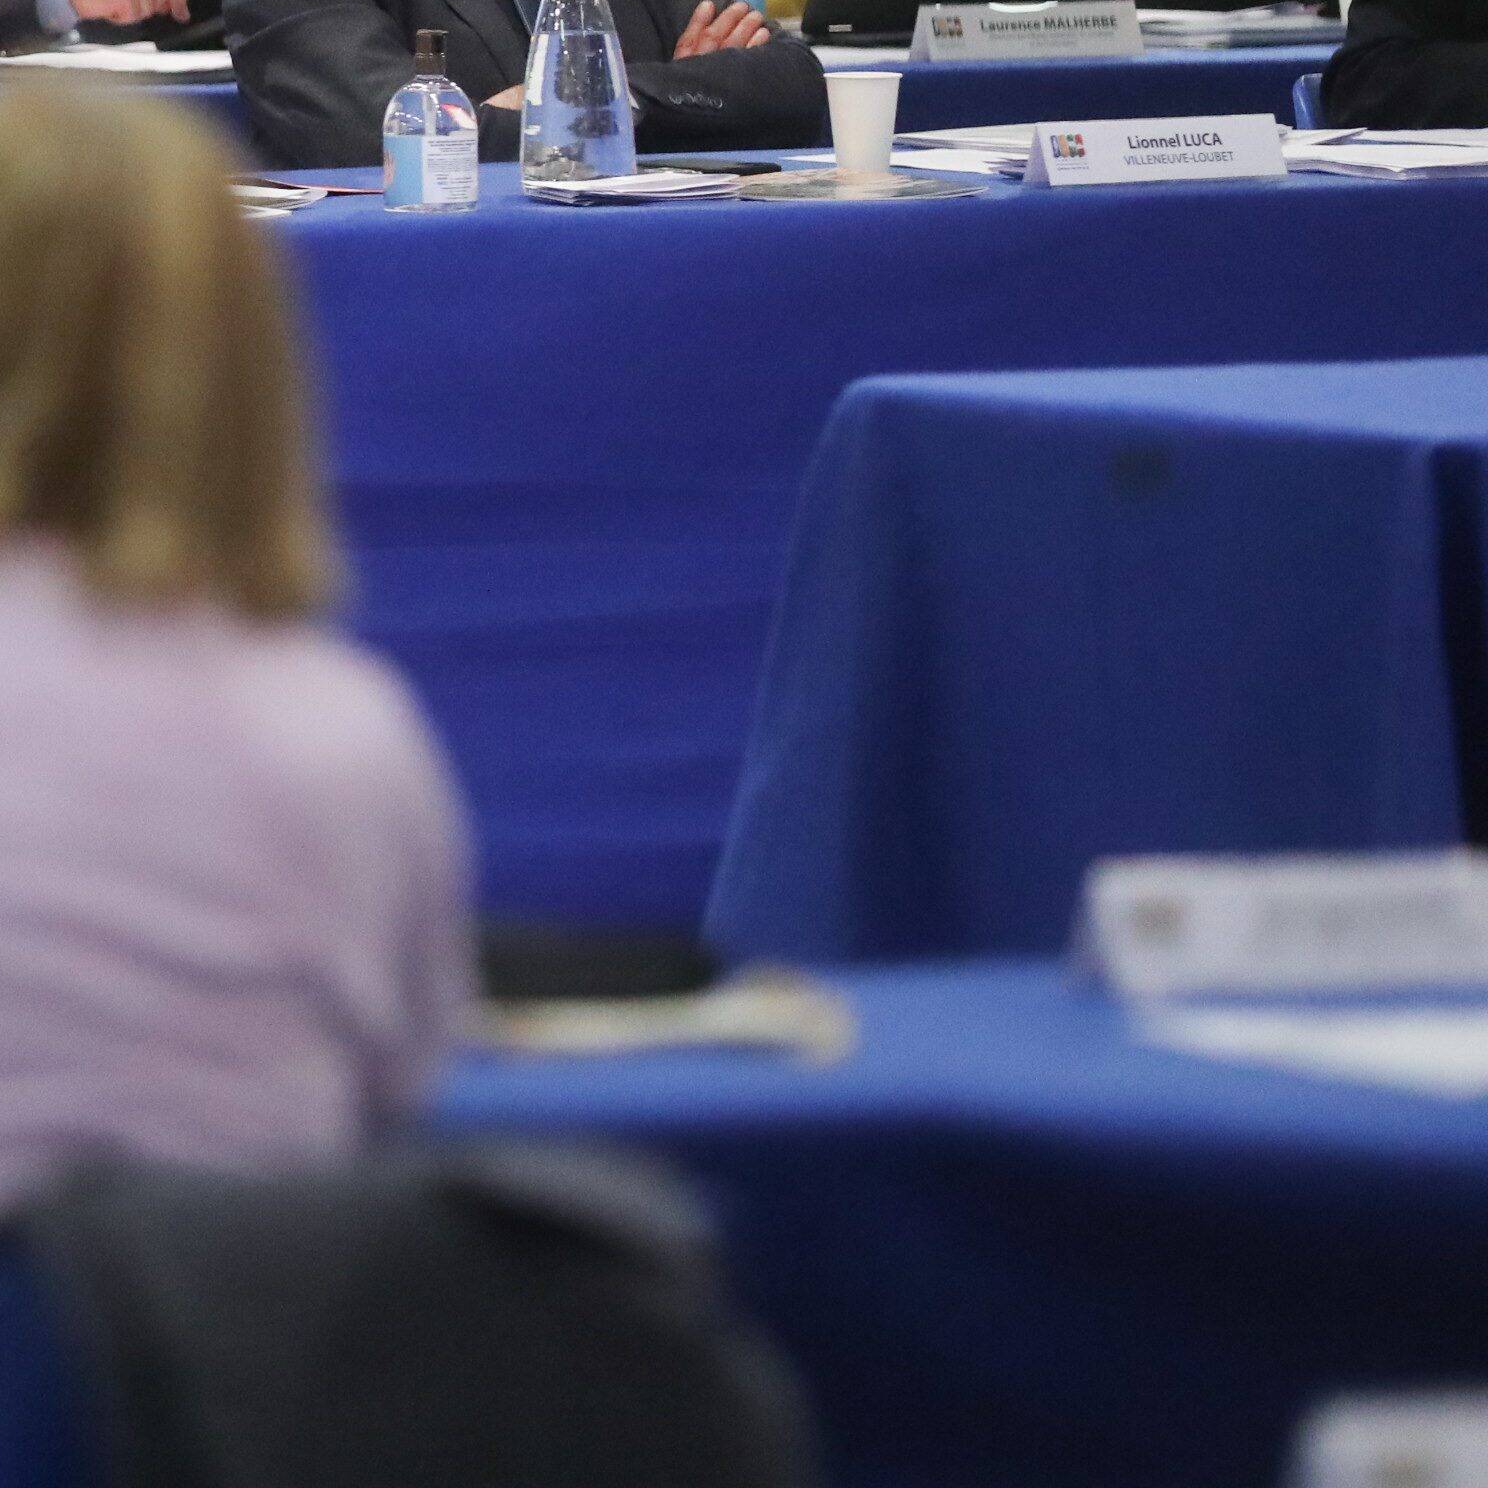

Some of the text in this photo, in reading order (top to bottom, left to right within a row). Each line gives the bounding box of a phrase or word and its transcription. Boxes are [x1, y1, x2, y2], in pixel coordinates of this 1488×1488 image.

[1127, 132, 1223, 150] Lionnel LUCA
[1123, 151, 1234, 166] VILLENEUVE-LOUBET
